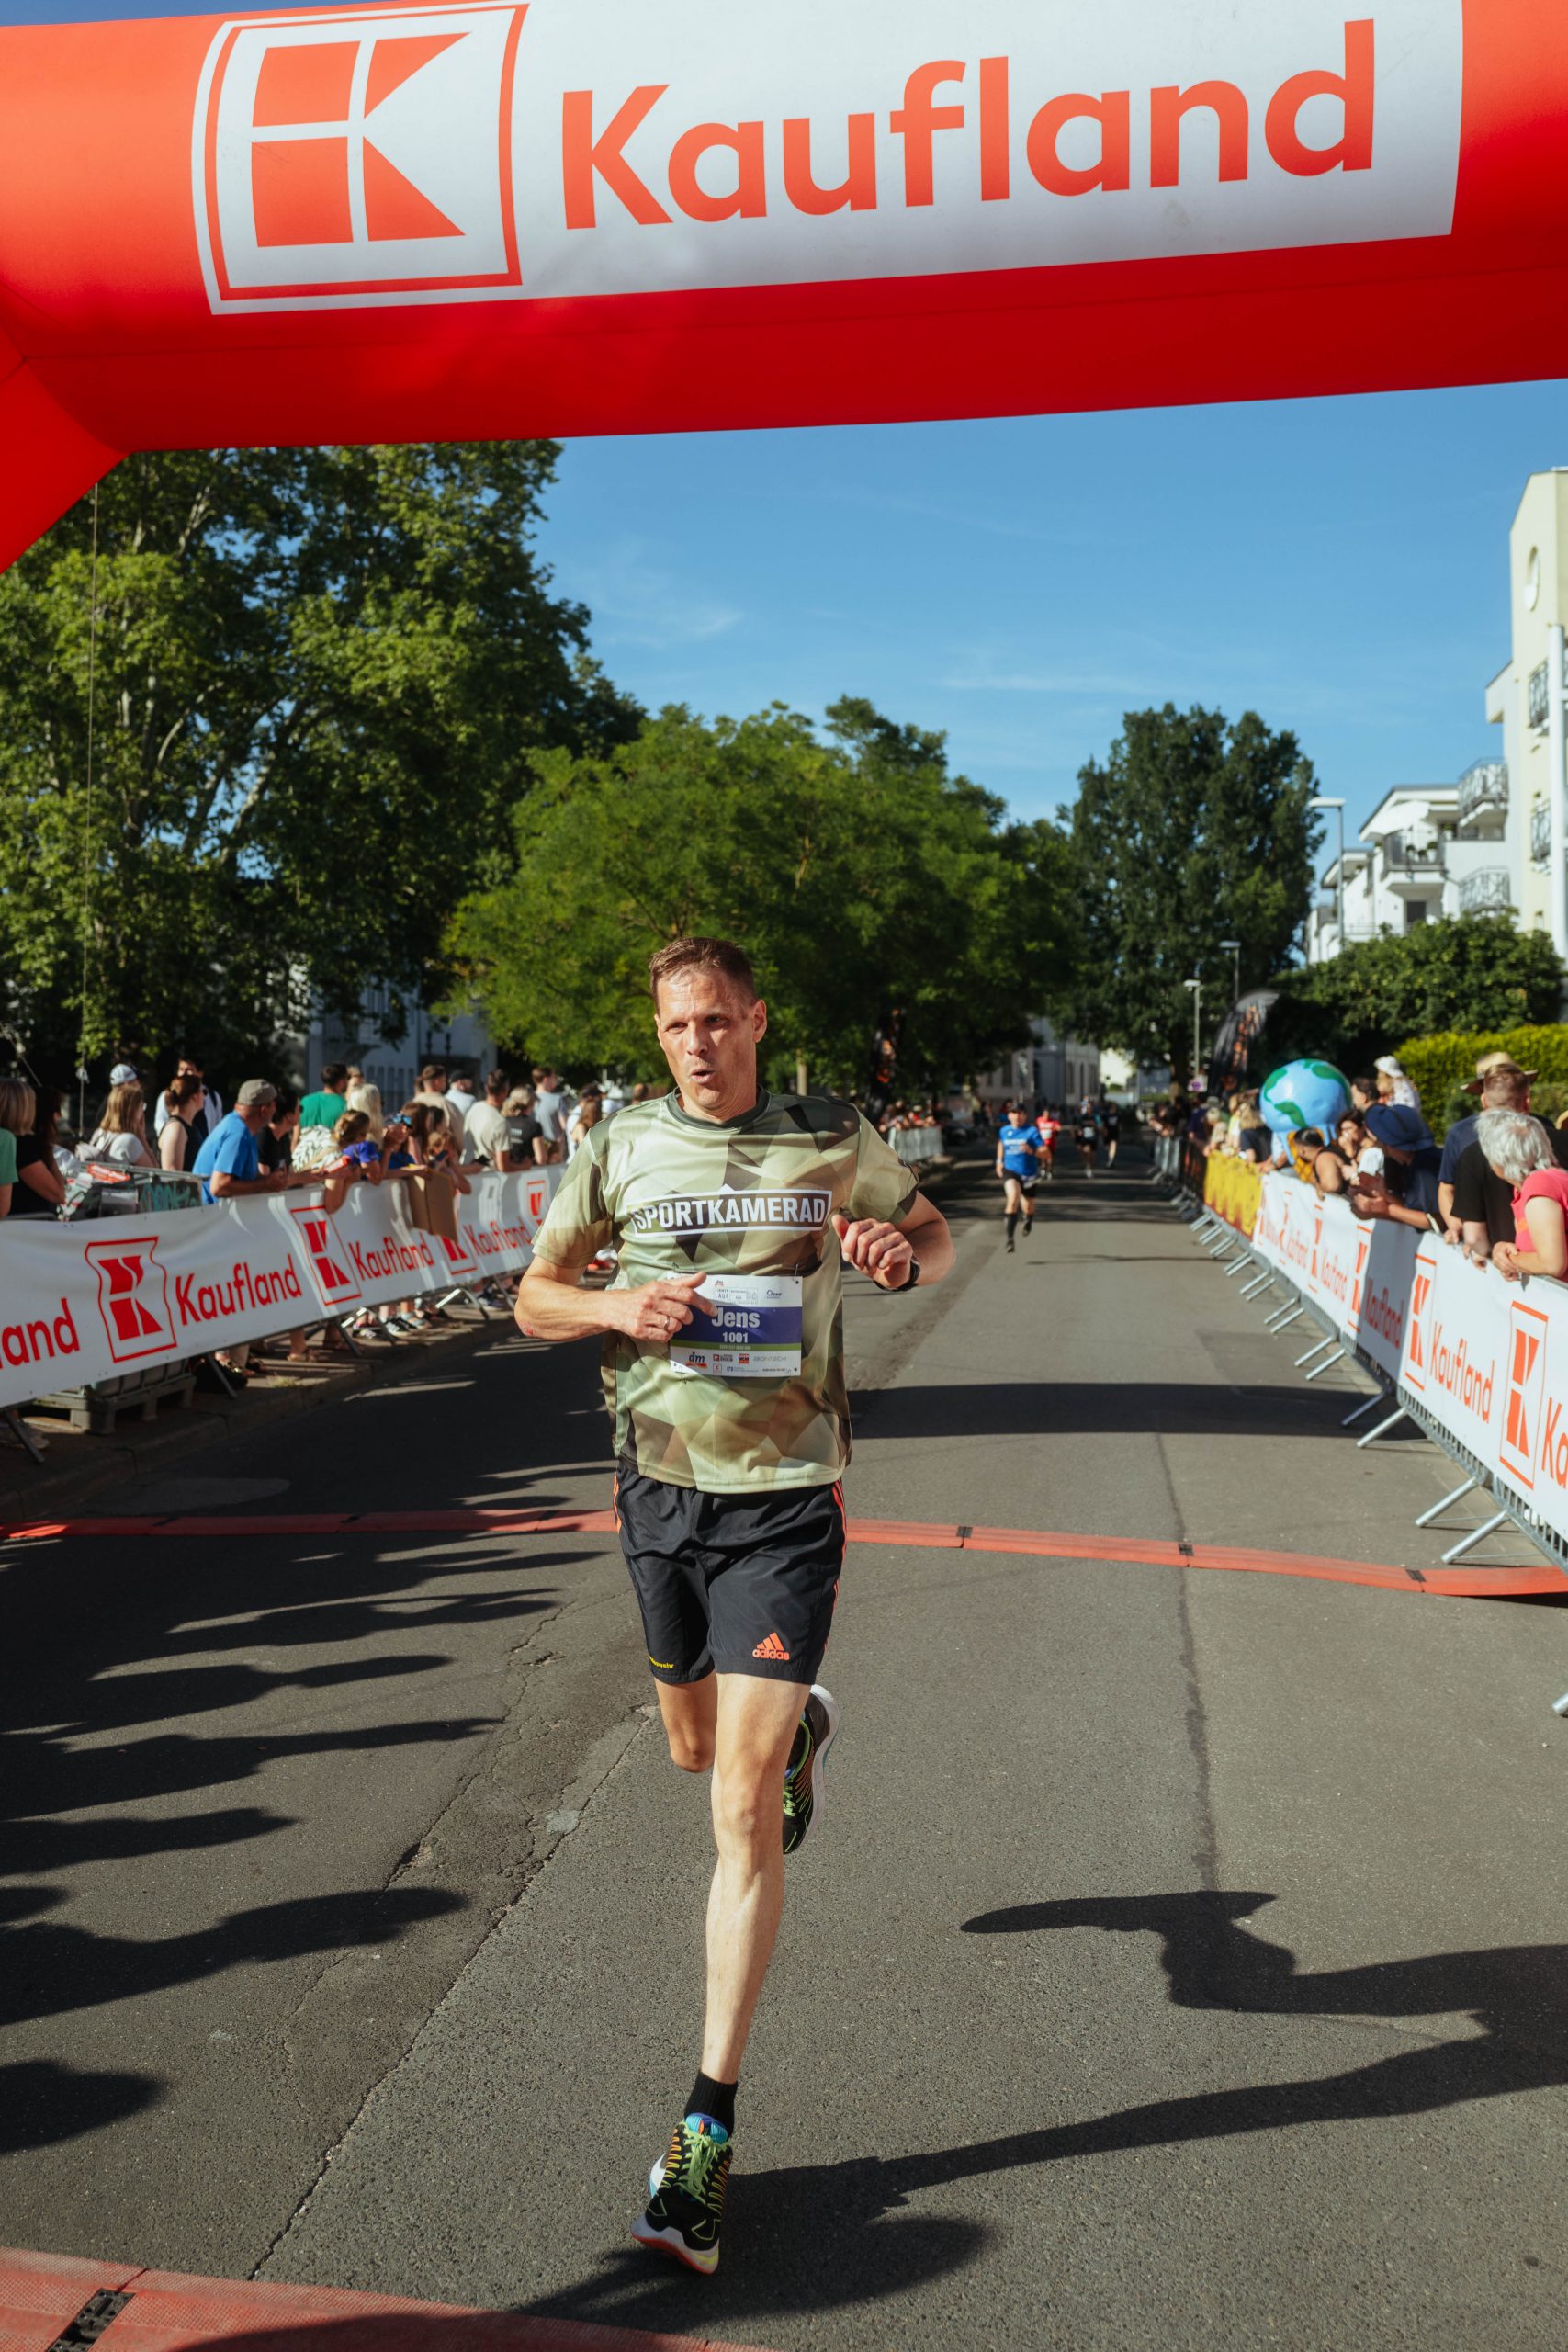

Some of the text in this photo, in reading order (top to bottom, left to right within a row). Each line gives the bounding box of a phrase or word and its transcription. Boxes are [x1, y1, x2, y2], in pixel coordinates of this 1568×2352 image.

[561, 17, 1375, 231] Kaufland
[633, 1196, 826, 1231] SPORTKAMERAD
[0, 1296, 80, 1369] and
[175, 1253, 302, 1327] Kaufland
[348, 1231, 435, 1282] Kaufland
[463, 1216, 532, 1259] Kaufland
[711, 1307, 761, 1329] Jens
[722, 1331, 749, 1343] 1001
[688, 1352, 705, 1363] dm
[1363, 1278, 1404, 1351] Kaufland
[1430, 1321, 1495, 1424] Kaufland
[1541, 1396, 1568, 1489] Ka
[752, 1648, 790, 1661] adidas
